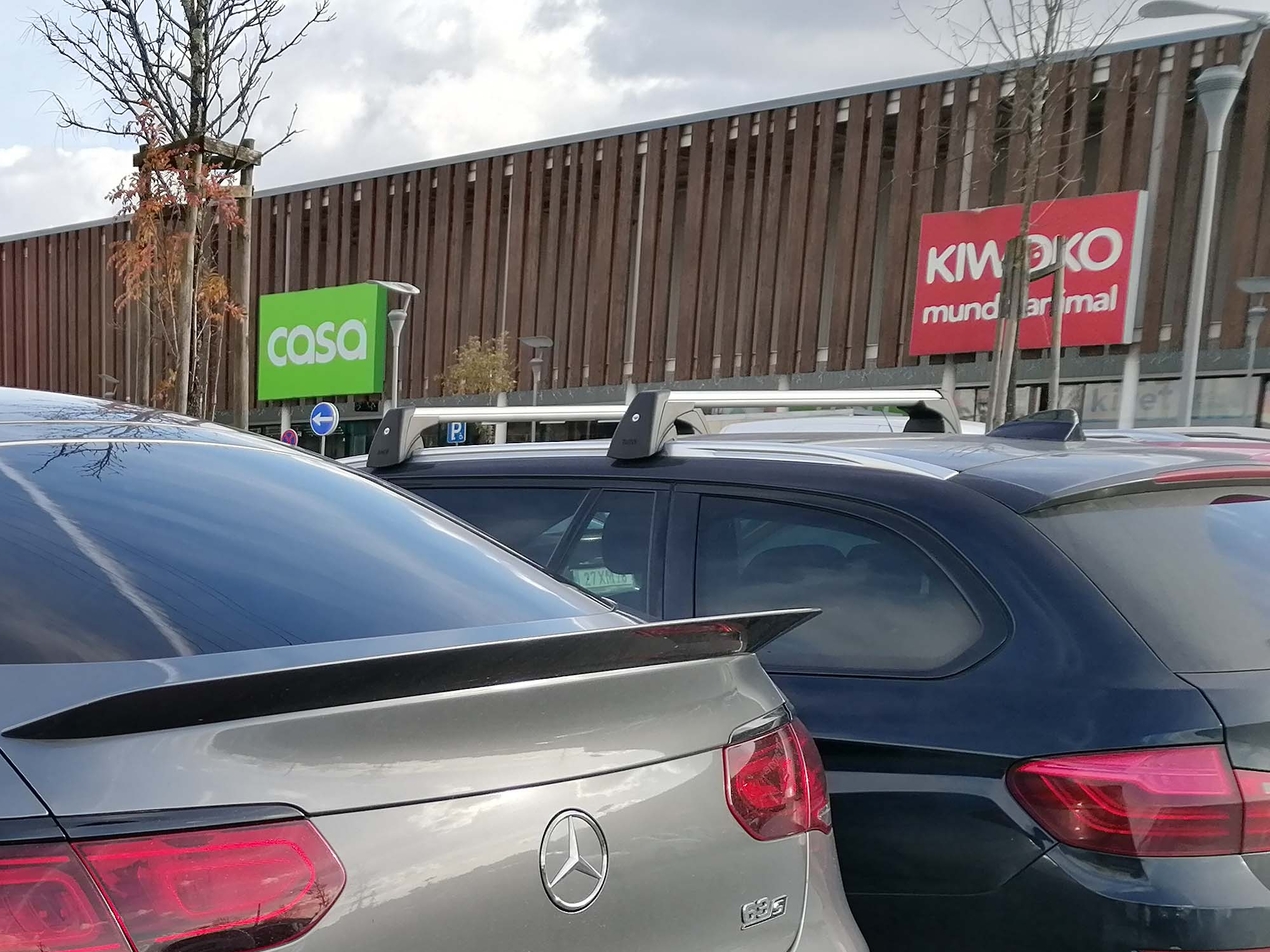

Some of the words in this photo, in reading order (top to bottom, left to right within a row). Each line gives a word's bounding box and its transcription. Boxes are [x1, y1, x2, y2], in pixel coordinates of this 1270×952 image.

[926, 227, 1123, 284] KIWOKO
[267, 319, 367, 367] casa
[1091, 387, 1173, 413] kiet
